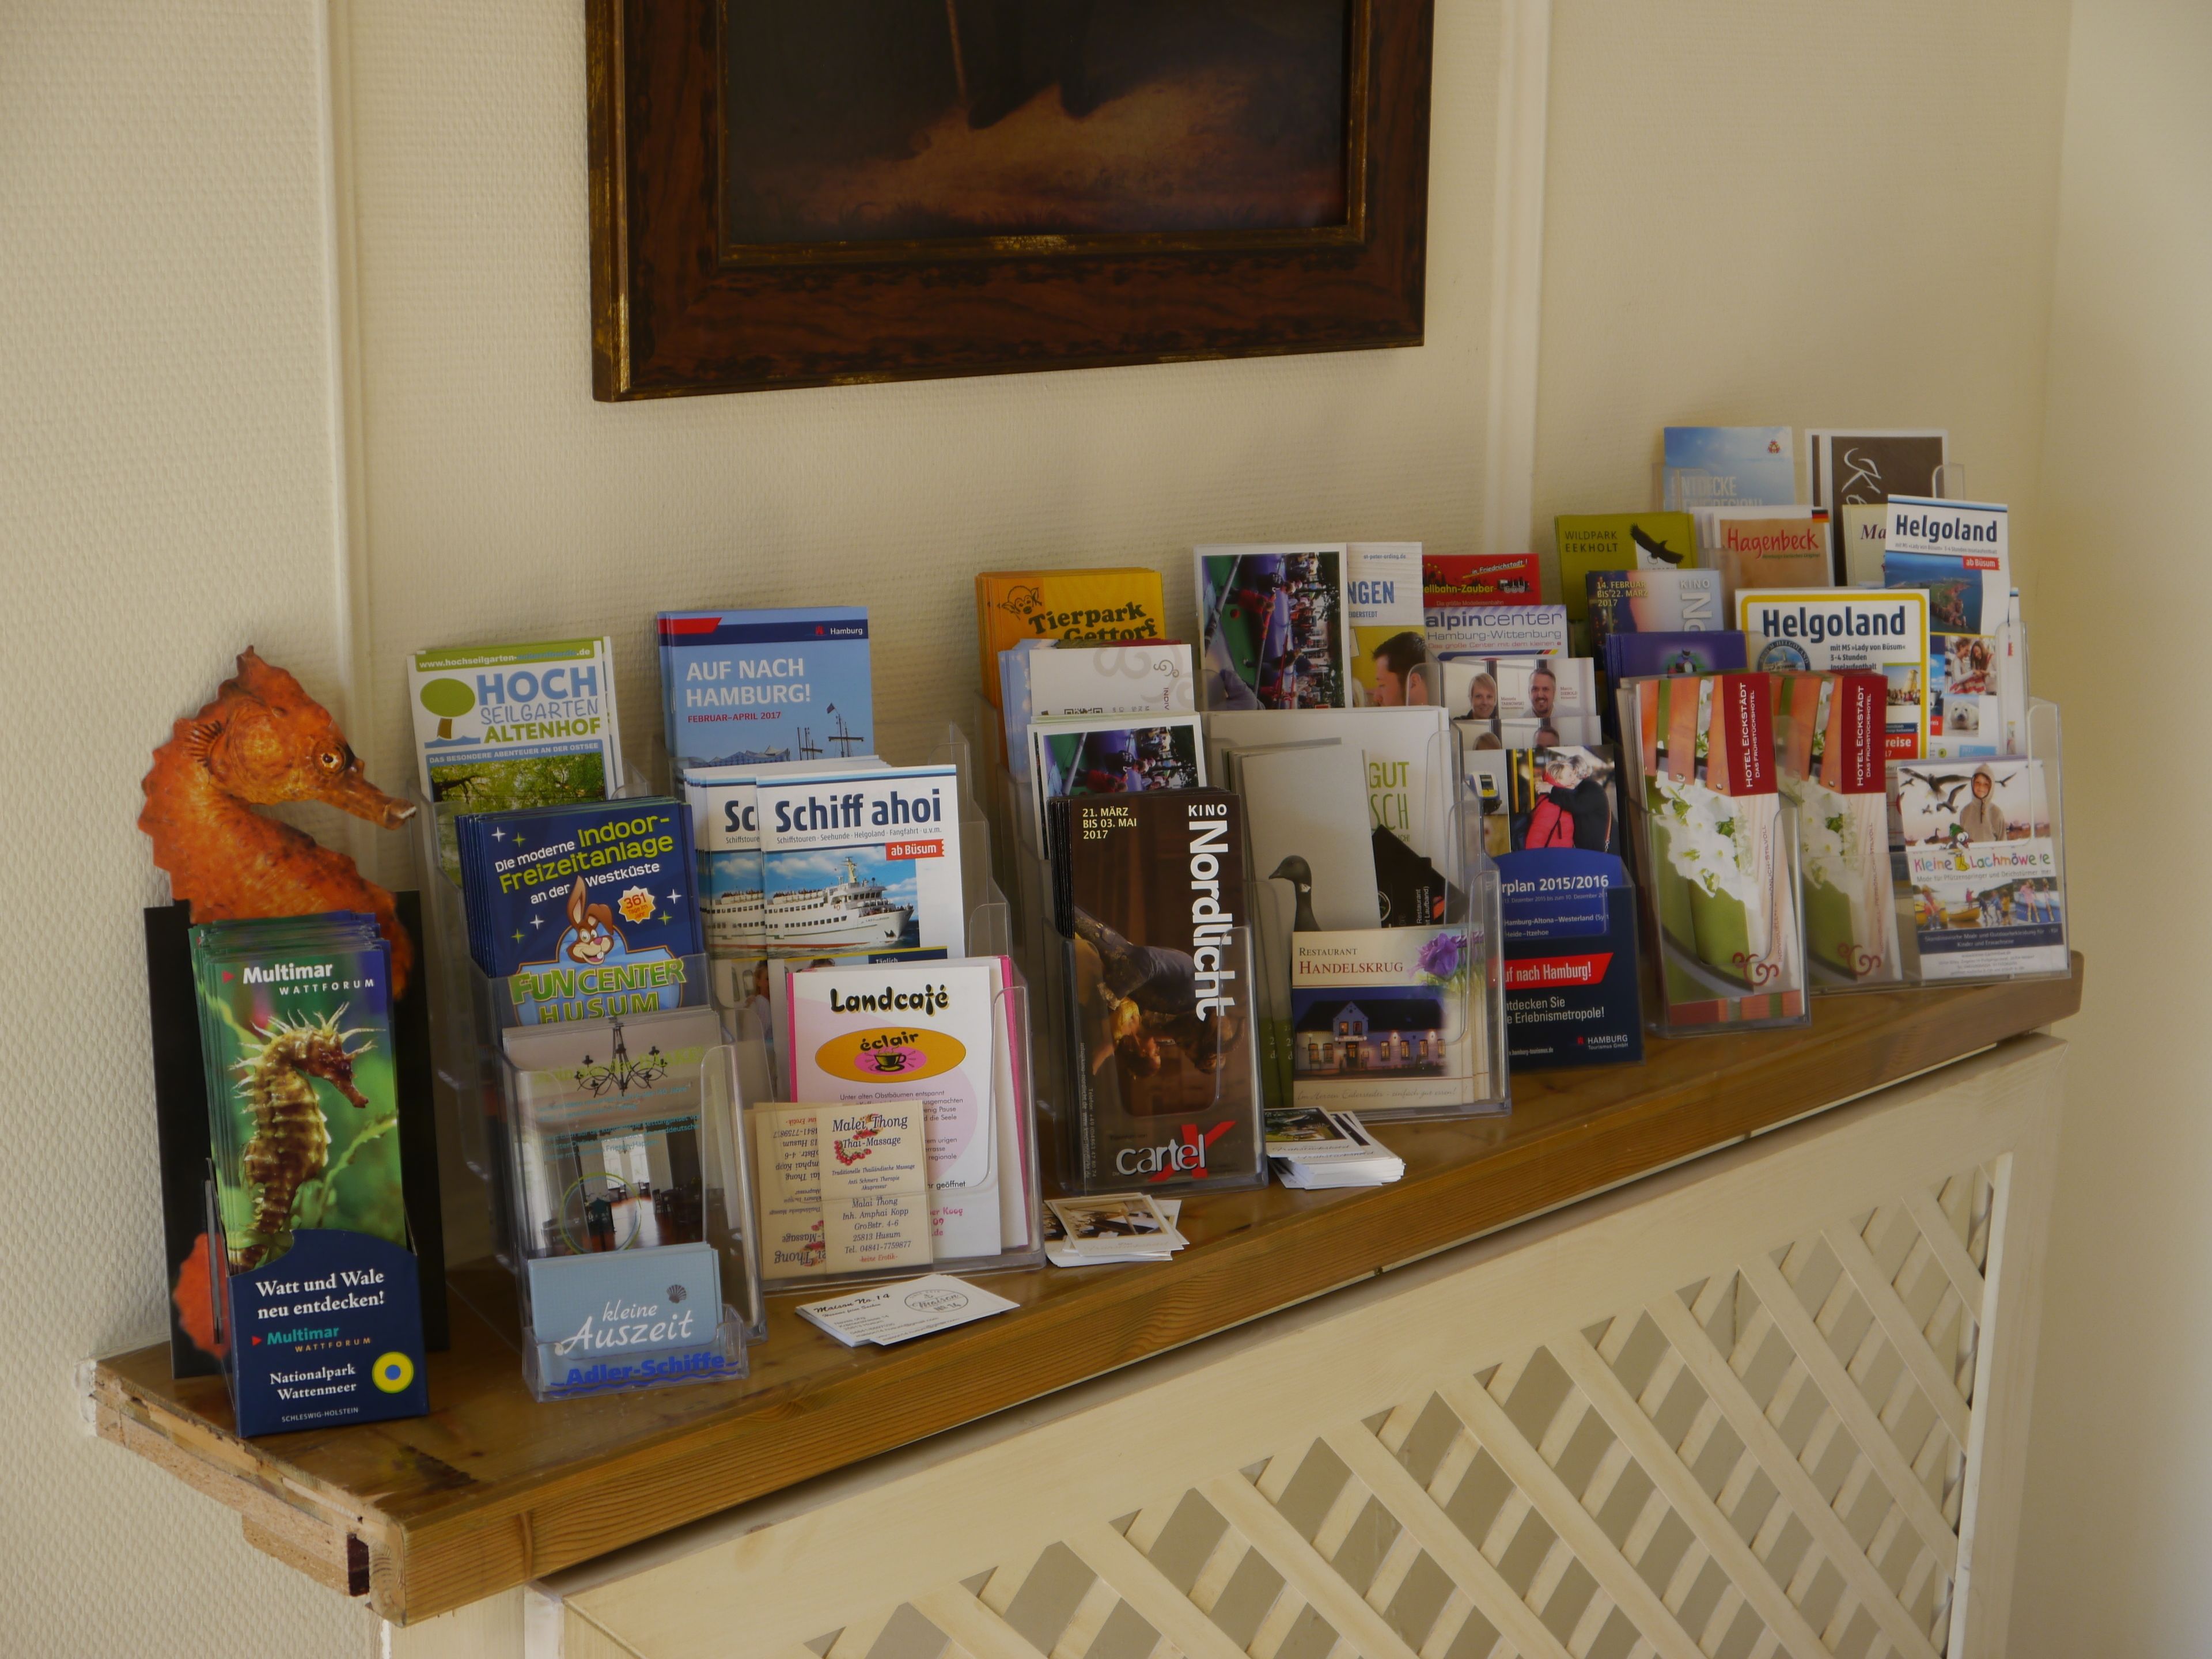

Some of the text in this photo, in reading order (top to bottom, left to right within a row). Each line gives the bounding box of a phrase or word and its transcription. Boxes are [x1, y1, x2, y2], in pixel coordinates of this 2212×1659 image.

[1565, 531, 1618, 540] WILDPARK
[1896, 514, 1997, 543] Helgoland
[1565, 543, 1618, 552] EEKHOLT
[1728, 528, 1819, 559] Hagenbeck
[1347, 581, 1395, 604] NGEN
[1680, 579, 1710, 589] KINO
[1028, 601, 1147, 635] Tierpark
[1426, 611, 1562, 630] alpincenter
[1763, 605, 1906, 644] Helgoland
[830, 627, 863, 635] Hamburg
[1427, 630, 1562, 642] Hamburg-Wittenburg
[686, 658, 804, 681] AUF NACH
[476, 666, 598, 706] HOCH
[686, 683, 811, 707] HAMBURG!
[480, 699, 599, 725] SEILGARTEN
[760, 711, 782, 720] 2017
[484, 717, 601, 744] ALTENHOF
[1749, 690, 1760, 759] FRÜHSTÜCKSHOTEL
[1738, 682, 1754, 789] HOTEL EICKSTÄDT
[1856, 685, 1864, 787] HOTEL EICKSTÄDT
[1885, 736, 1911, 748] reise
[446, 751, 492, 762] BESONDERE
[494, 748, 539, 759] ABENTEUER
[570, 742, 599, 750] OSTSEE
[1369, 762, 1410, 788] GUT
[775, 787, 942, 833] Schiff ahoi
[1082, 806, 1129, 818] 21. MÄRZ
[1188, 804, 1228, 817] KINO
[1082, 818, 1137, 828] BIS 03. MAI
[494, 815, 670, 873] Die moderne Indoor-
[777, 826, 942, 845] Schiffstouren Seehunde Helgoland Fangfahrt u.v.m.
[1082, 830, 1109, 839] 2017
[891, 843, 937, 857] ab Büsum
[499, 835, 674, 894] Freizeitanlage
[1914, 853, 2037, 873] Kleine Lachmöwe
[530, 862, 660, 904] an der Westküste
[1540, 874, 1609, 891] 2015/2016
[1944, 873, 1987, 882] Pfützenspringer
[624, 892, 646, 909] 361
[1188, 820, 1236, 1022] Nordlicht
[1299, 947, 1358, 956] RESTAURANT
[243, 963, 334, 984] Multimar
[1299, 960, 1404, 975] HANDELSKRUG
[1516, 961, 1592, 982] nach Hamburg!
[279, 978, 374, 995] WATTFORUM
[540, 991, 659, 1024] HUSUM
[830, 983, 950, 1016] Landcafé
[1550, 997, 1566, 1008] Sie
[1515, 1006, 1605, 1024] Erlebnismetropole!
[859, 1031, 919, 1052] éclair
[1588, 1034, 1628, 1044] HAMBURG
[872, 1115, 908, 1130] Thong
[938, 1137, 957, 1146] urigen
[1115, 1133, 1206, 1176] cartel
[832, 1168, 860, 1176] Traditionelle
[862, 1164, 893, 1173] Thailändische
[936, 1181, 966, 1190] geöffnet
[876, 1195, 897, 1206] Thong
[859, 1209, 888, 1219] Amphai
[891, 1208, 908, 1216] Kopp
[943, 1207, 963, 1216] Koog
[853, 1232, 900, 1242] 25813 Husum
[844, 1241, 911, 1254] Tel. 04841-7759877
[774, 1249, 811, 1266] Thong
[255, 1268, 385, 1297] Watt und Wale
[257, 1290, 385, 1319] neu entdecken!
[603, 1300, 658, 1322] kleine
[267, 1327, 340, 1346] Multimar
[554, 1310, 694, 1356] Auszeit
[295, 1337, 371, 1353] WATTFORUM
[270, 1363, 356, 1384] Nationalpark
[566, 1351, 726, 1386] Adler-Schiffe
[276, 1382, 357, 1400] Wattenmeer
[282, 1407, 359, 1423] SCHLESWIG-HOLSTEIN
